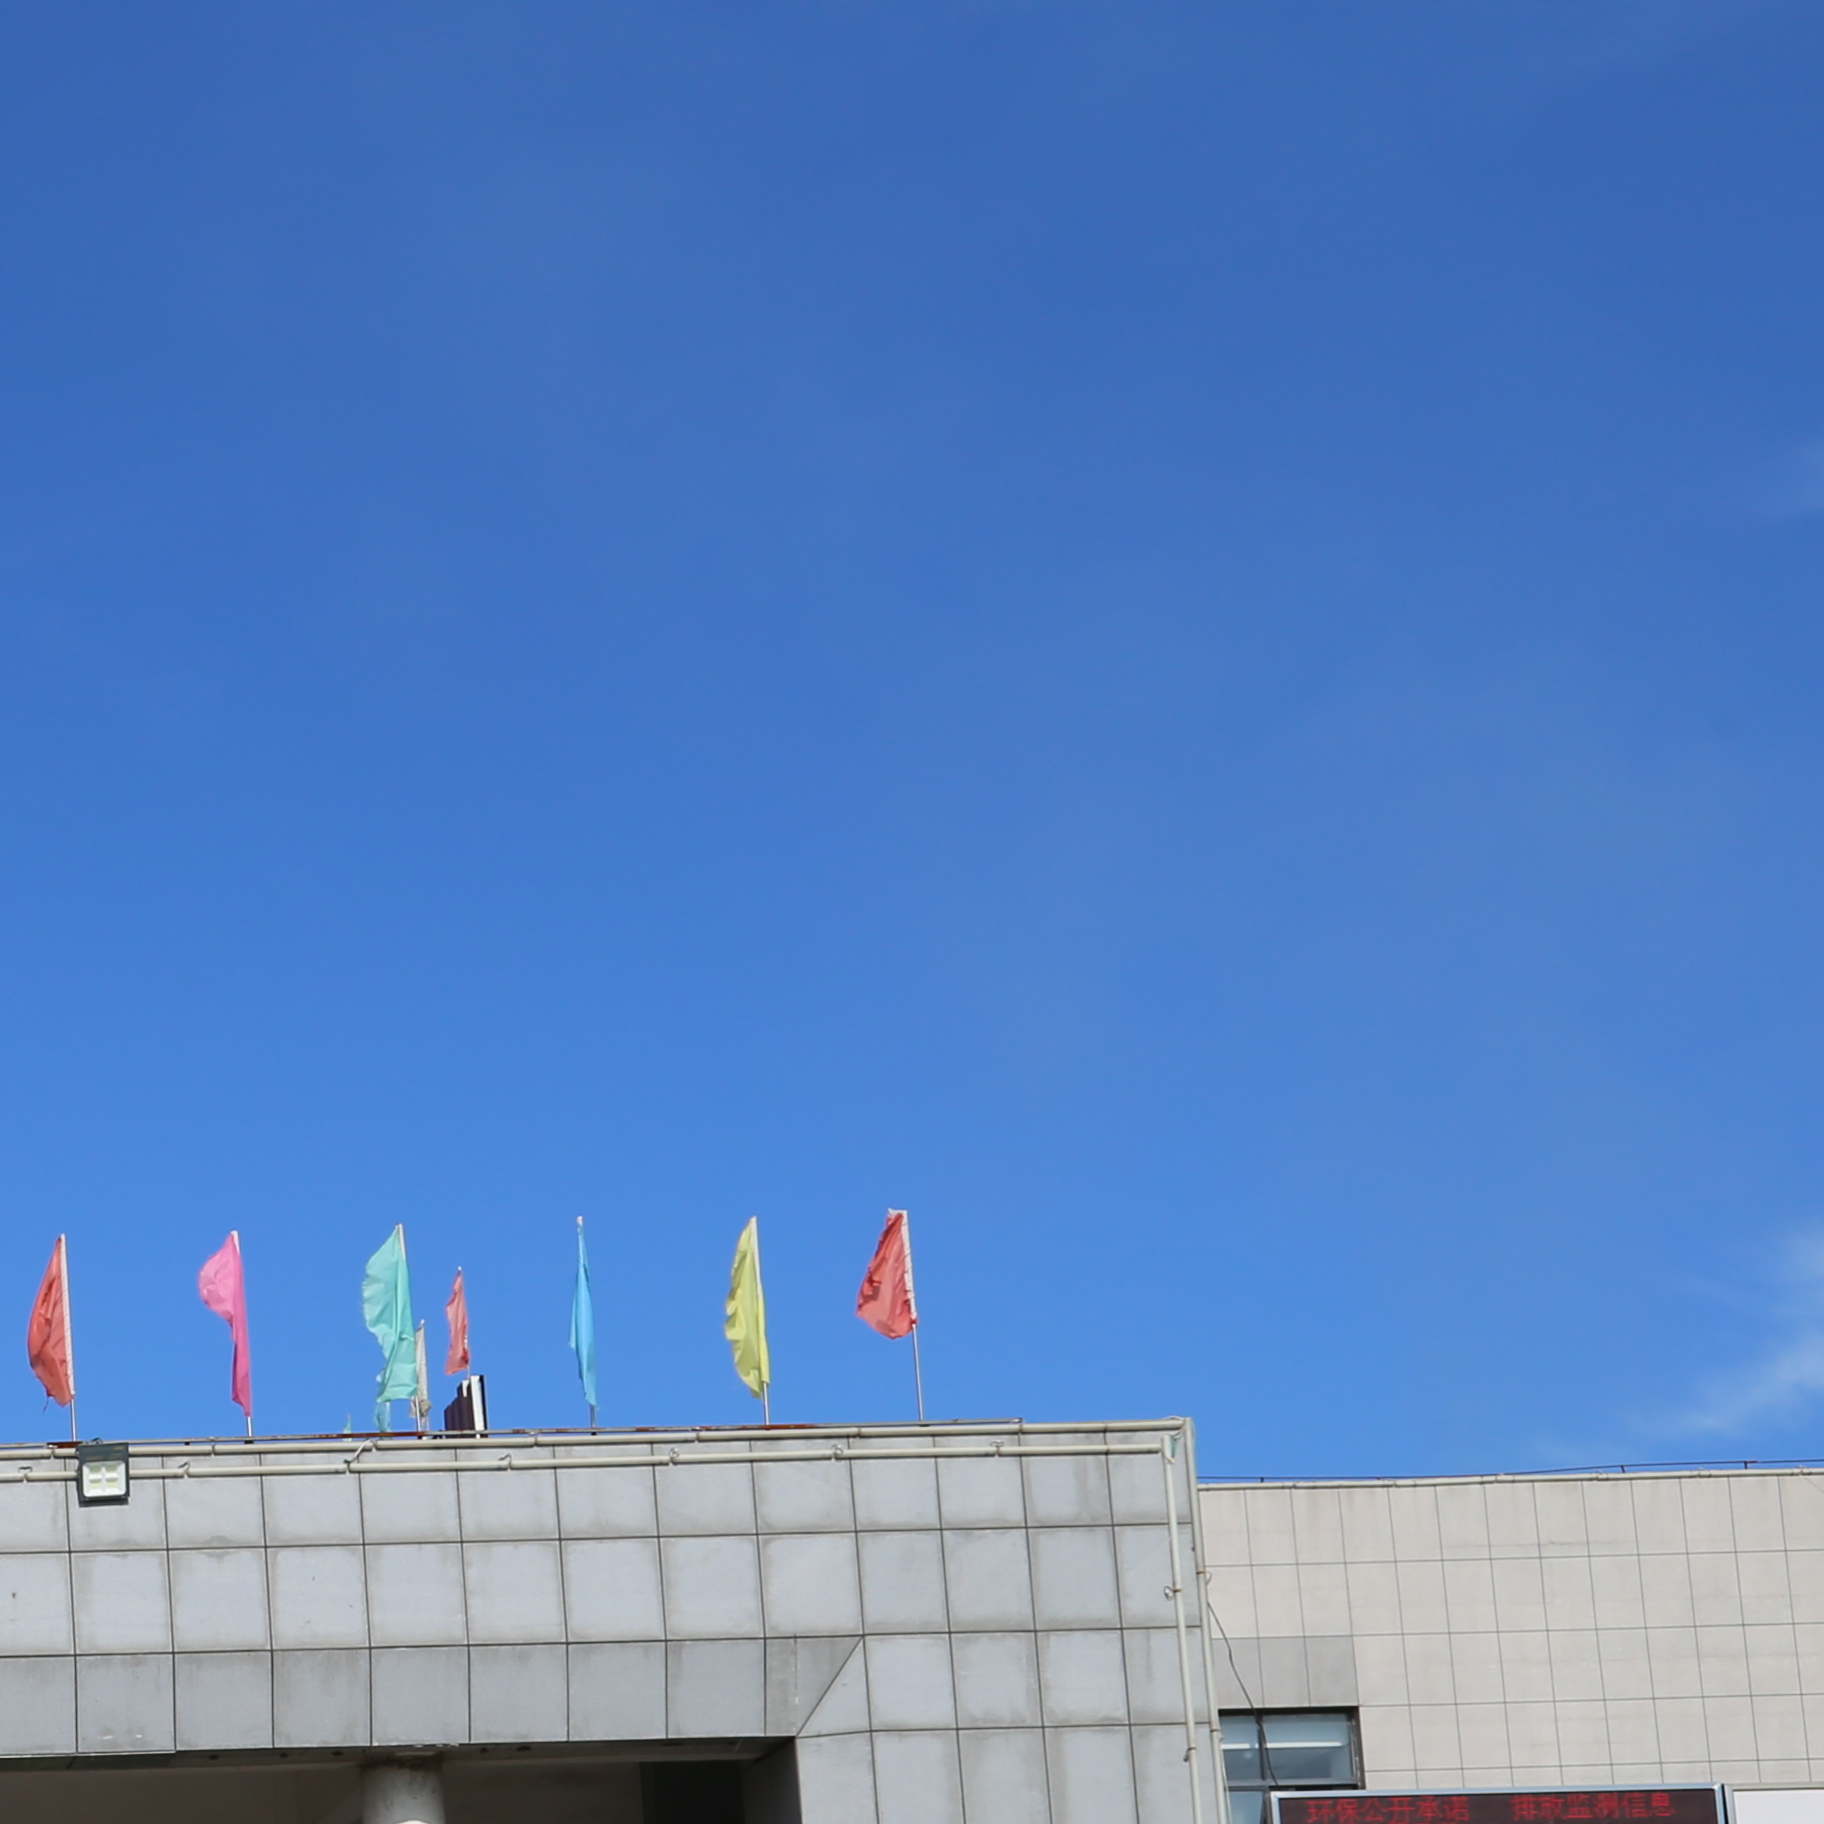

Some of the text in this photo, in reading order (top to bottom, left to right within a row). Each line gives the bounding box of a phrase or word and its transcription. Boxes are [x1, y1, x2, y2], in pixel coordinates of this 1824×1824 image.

[1305, 1795, 1471, 1824] 环保公开承诺
[1510, 1791, 1677, 1820] 排放监测信息
